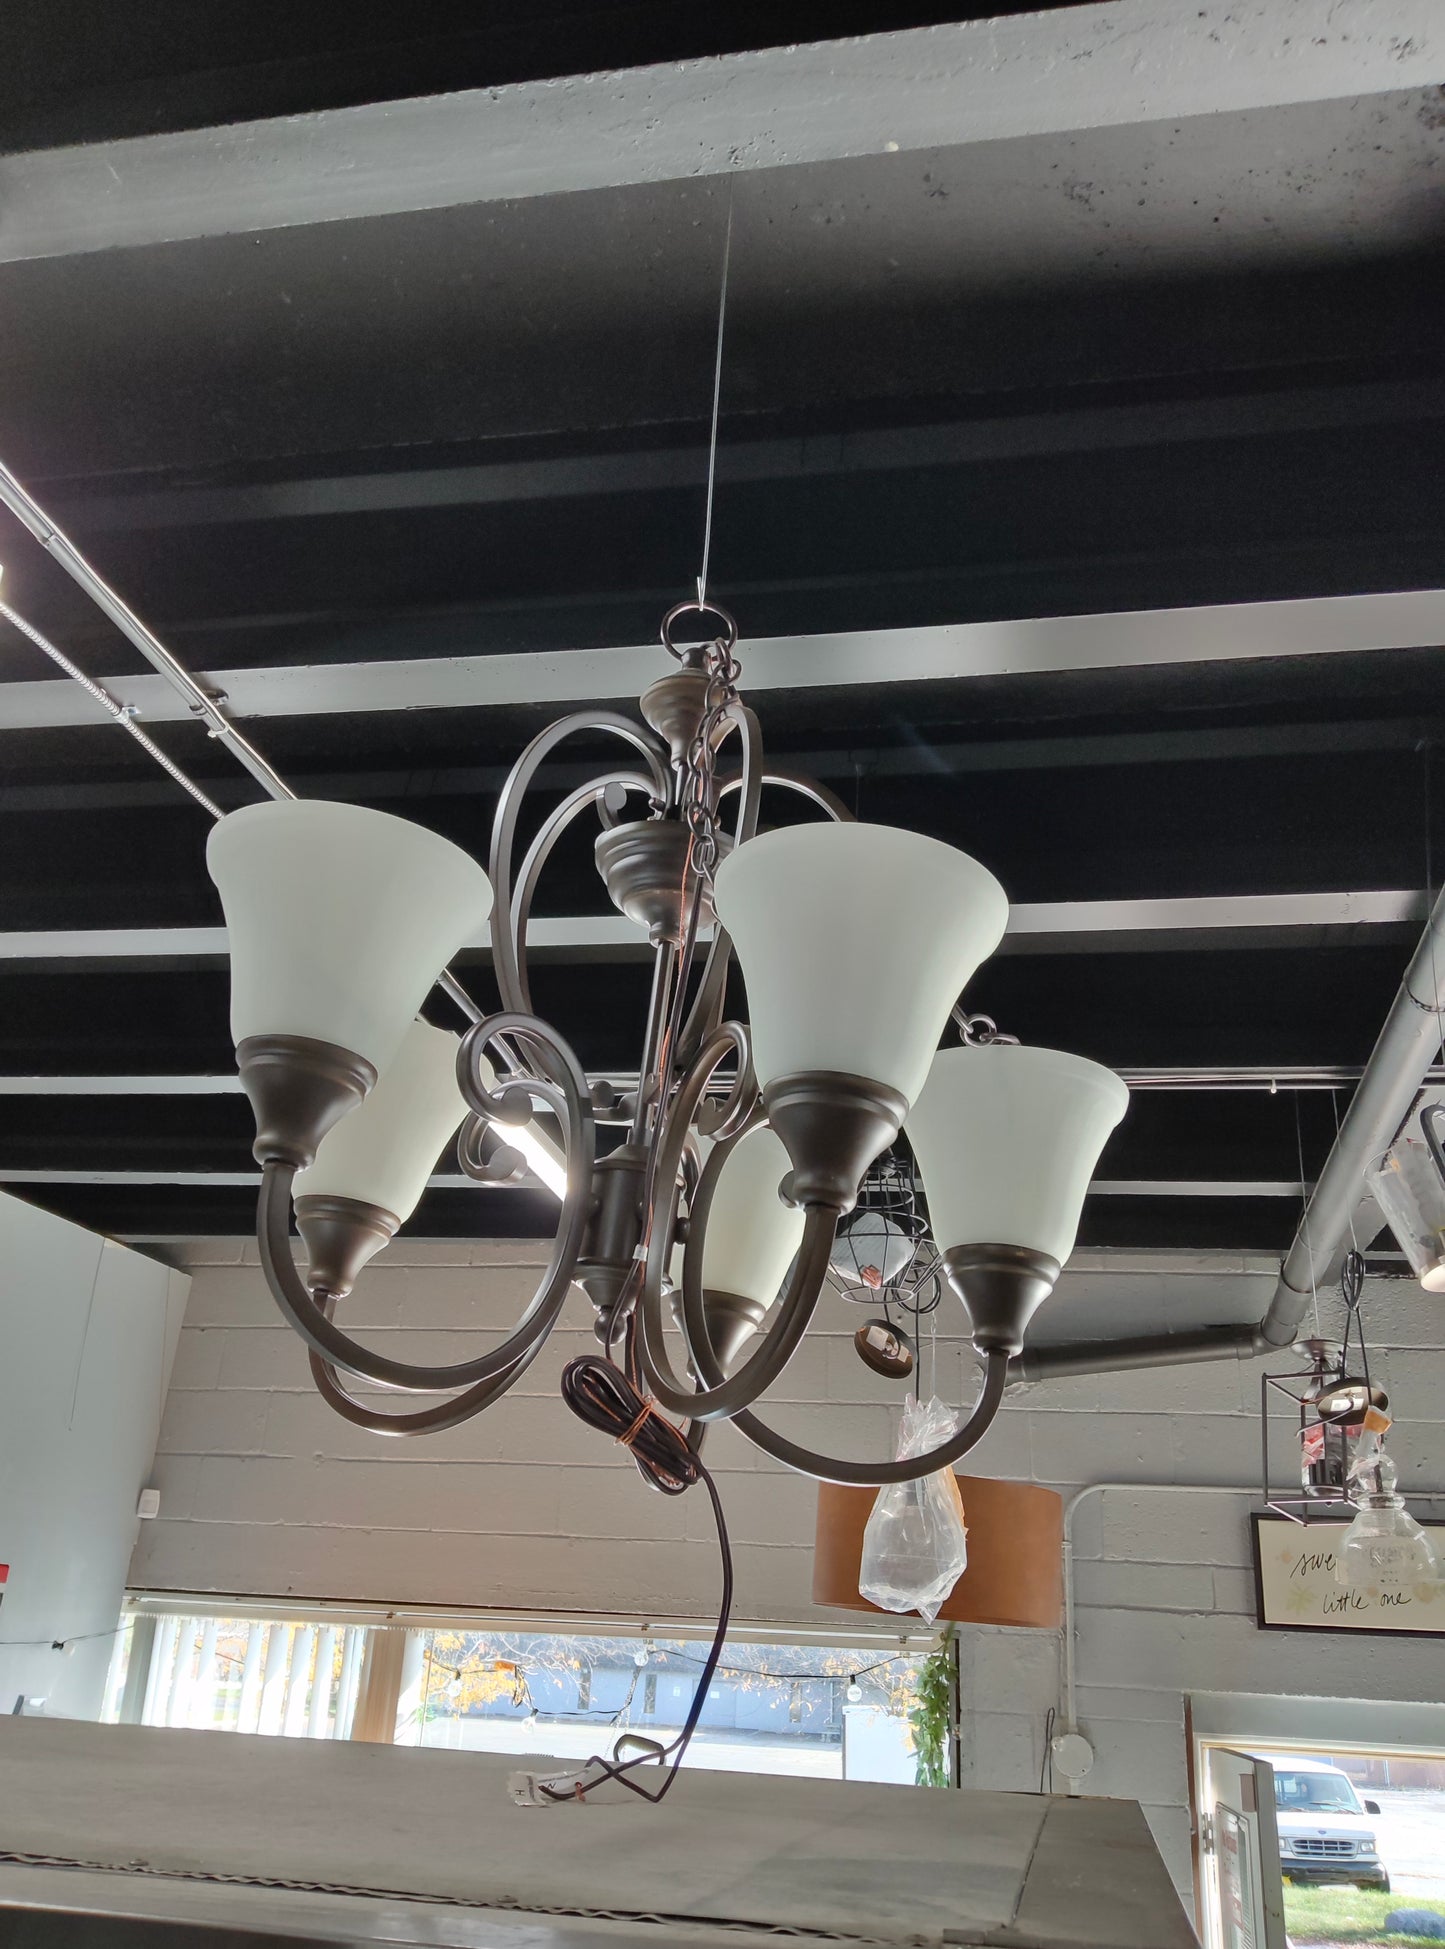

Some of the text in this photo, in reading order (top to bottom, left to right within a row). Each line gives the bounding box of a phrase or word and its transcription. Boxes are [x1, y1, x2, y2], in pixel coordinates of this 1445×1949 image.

[1290, 1552, 1336, 1579] swe
[1322, 1588, 1412, 1615] little one
